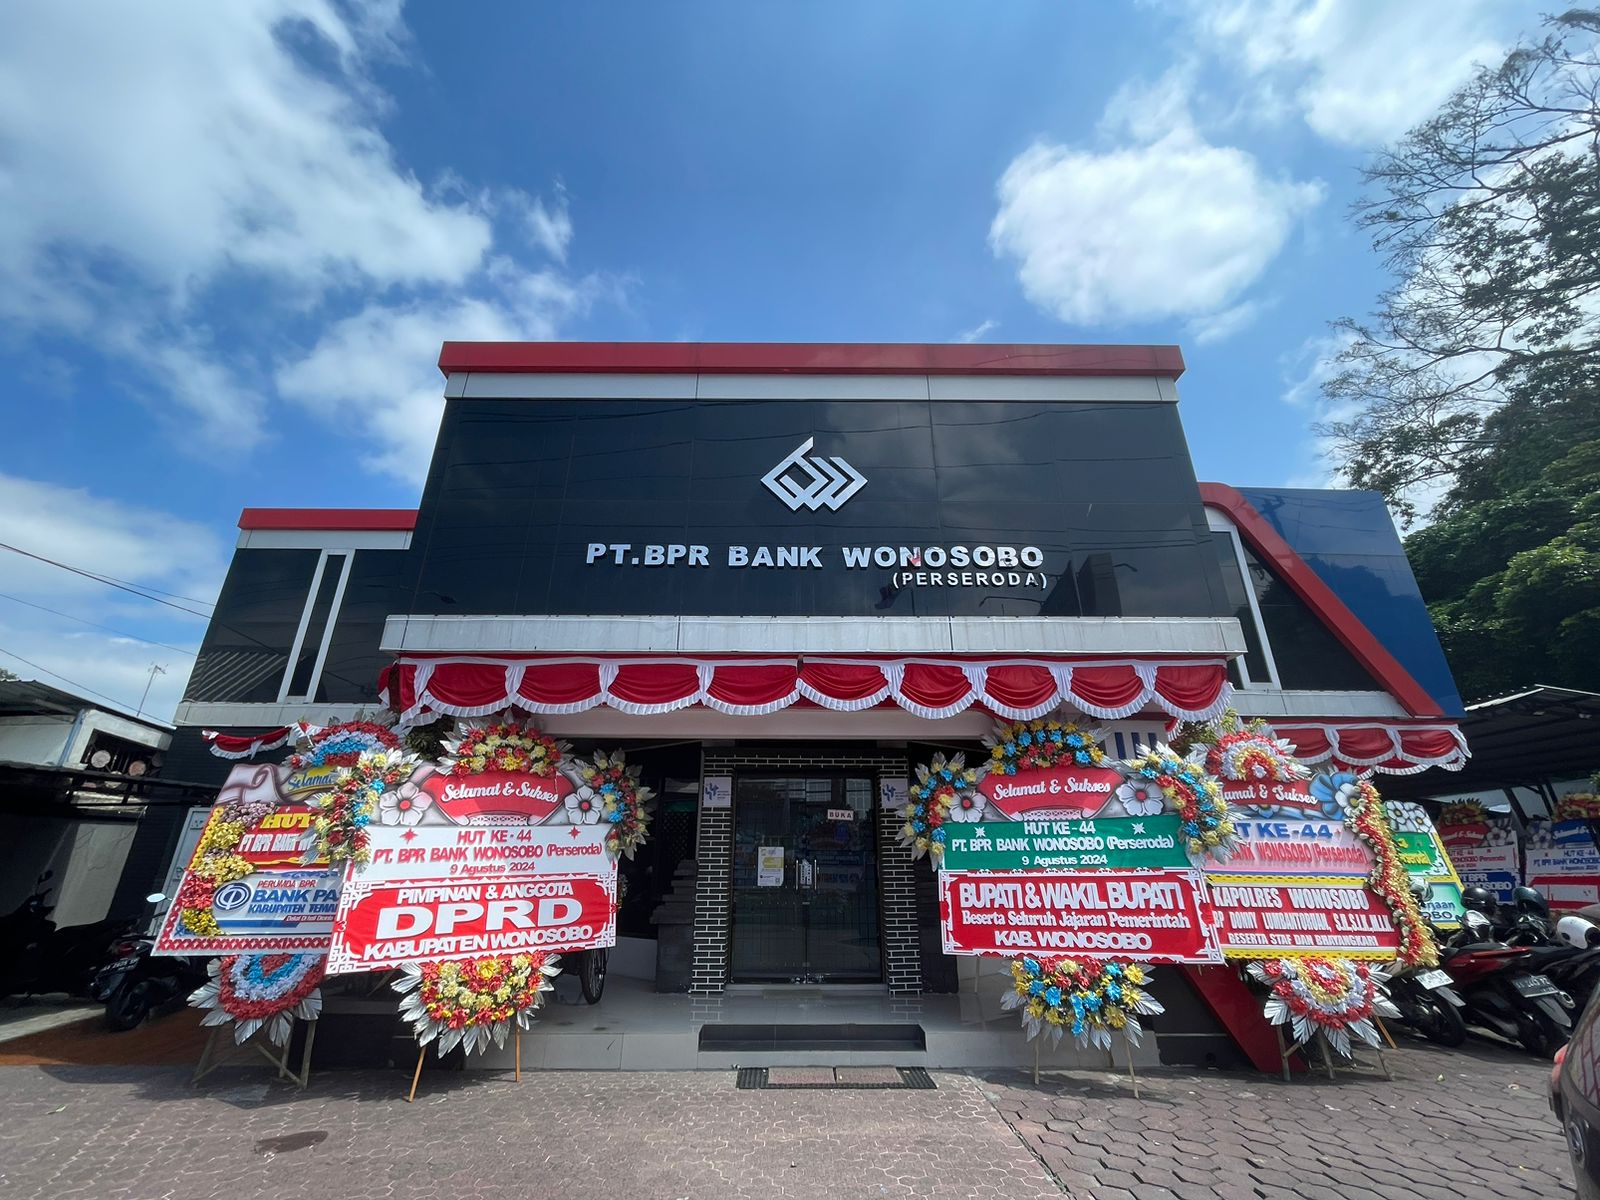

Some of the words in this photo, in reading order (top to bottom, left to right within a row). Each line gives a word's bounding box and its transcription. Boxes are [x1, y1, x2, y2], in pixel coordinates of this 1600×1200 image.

[728, 546, 823, 567] BANK
[842, 546, 1044, 568] WONOSOBO
[892, 572, 1047, 589] (PERSERODA)
[441, 782, 501, 802] Selamat
[503, 783, 515, 796] &
[516, 782, 559, 803] Sukses
[993, 781, 1046, 800] Selamat
[1049, 779, 1061, 792] &
[1064, 777, 1111, 793] Sukses
[1259, 784, 1269, 799] &
[1272, 785, 1319, 805] Sukses
[260, 813, 316, 829] HUT
[829, 811, 852, 819] BUKA
[1024, 821, 1050, 835] HUT
[251, 834, 273, 852] BPR
[457, 830, 486, 845] HUT
[951, 839, 967, 852] PT.
[970, 838, 992, 851] BPR
[996, 838, 1030, 851] BANK
[1034, 836, 1104, 851] WONOSOBO
[1106, 834, 1175, 850] (Perseroda)
[372, 849, 392, 864] PT.
[397, 848, 425, 863] BPR
[430, 847, 469, 862] BANK
[473, 844, 544, 861] WONOSOBO
[546, 842, 602, 857] (Perseroda)
[1022, 855, 1029, 866] 9
[1033, 855, 1078, 868] Agustus
[1080, 854, 1108, 865] 2024
[1255, 841, 1313, 862] WONOSOBO
[1311, 842, 1368, 865] (Perseroda)
[450, 864, 457, 874] 9
[461, 863, 506, 876] Agustus
[509, 861, 535, 873] 2024
[257, 879, 296, 888] PERUMDA
[299, 879, 317, 888] BPR
[251, 889, 312, 903] BANK
[313, 889, 339, 902] PA
[397, 886, 481, 905] PIMPINAN
[485, 886, 499, 900] &
[500, 881, 574, 899] ANGGOTA
[959, 882, 1024, 909] BUPATI
[1025, 882, 1042, 909] &
[1039, 882, 1108, 910] WAKIL
[1106, 881, 1186, 910] BUPATI
[1211, 886, 1283, 909] KAPOLRES
[1287, 887, 1370, 911] WONOSOBO
[247, 903, 307, 914] KABUPATEN
[375, 898, 583, 940] DPRD
[961, 910, 1005, 926] Beserta
[1008, 911, 1057, 927] Seluruh
[1059, 911, 1107, 931] Jajaran
[1108, 911, 1191, 929] Pemerintah
[1229, 911, 1258, 929] DONNY
[363, 934, 489, 961] KABUPATEN
[490, 925, 593, 949] WONOSOBO
[1036, 930, 1153, 950] WONOSOBO
[1227, 932, 1269, 945] BESERTA
[1270, 933, 1292, 945] STAF
[1294, 934, 1314, 946] DAN
[1316, 934, 1379, 947] BHAYANGKARI
